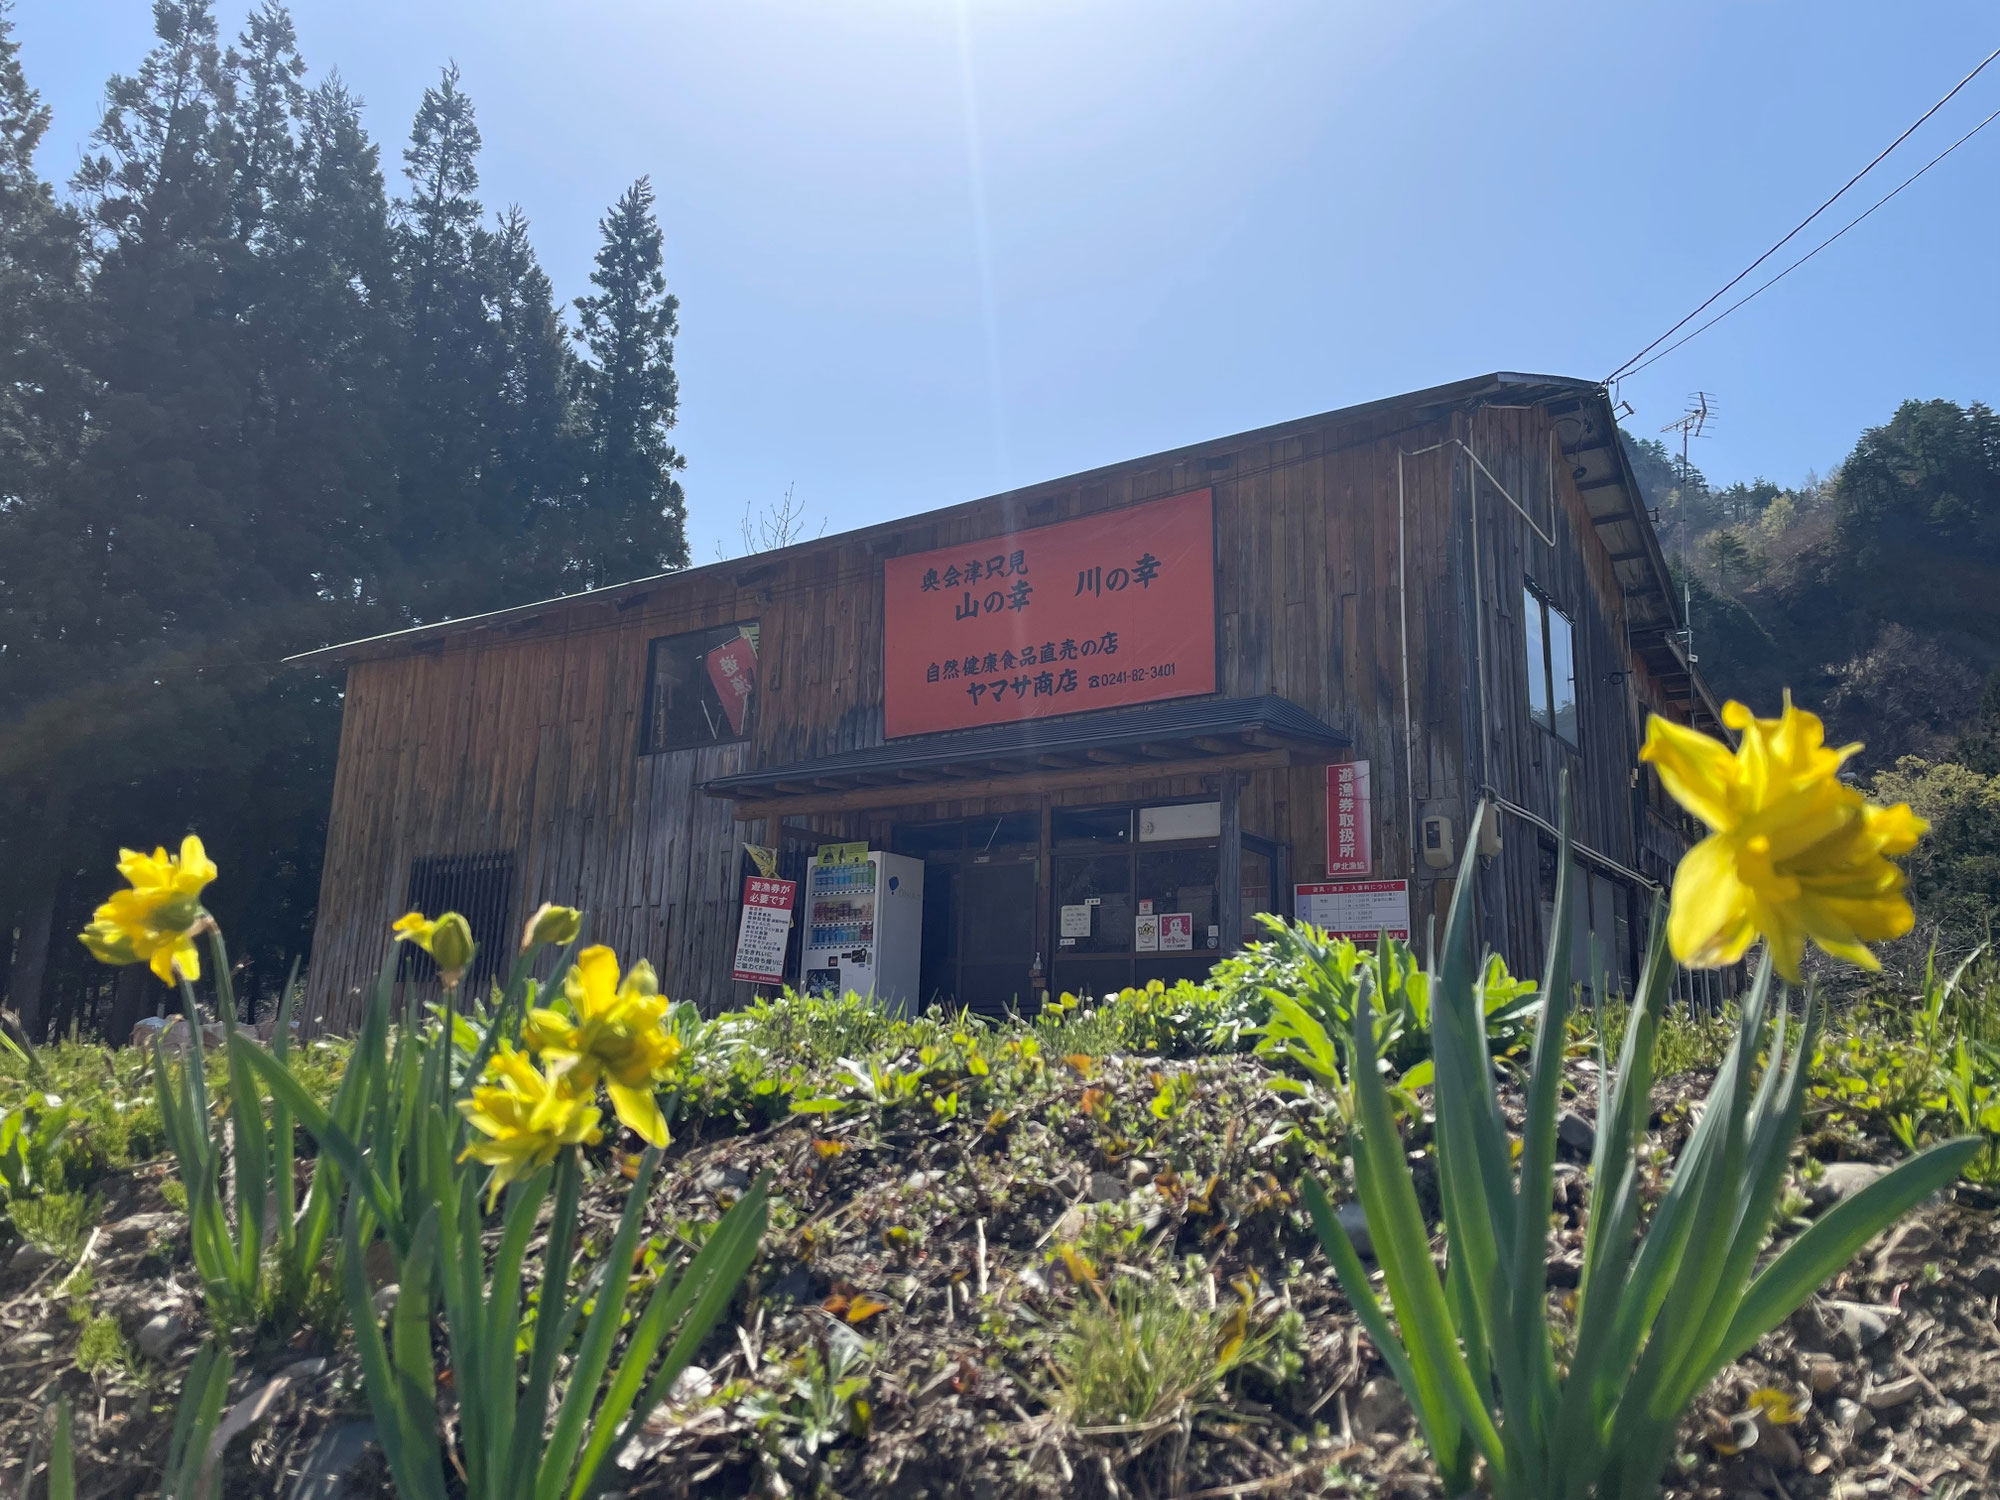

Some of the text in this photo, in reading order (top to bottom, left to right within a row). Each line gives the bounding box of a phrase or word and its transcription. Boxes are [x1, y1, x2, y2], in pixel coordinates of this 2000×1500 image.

[921, 550, 1028, 592] 奥会津只見
[955, 553, 1162, 621] 山の幸 川の幸
[926, 632, 1118, 683] 自然健康食品直売の店
[967, 663, 1175, 706] ヤマサ商店 0241-82-3401
[1338, 768, 1355, 858] 遊漁券取扱所
[750, 893, 788, 905] 必要です
[751, 881, 791, 894] 遊漁券が
